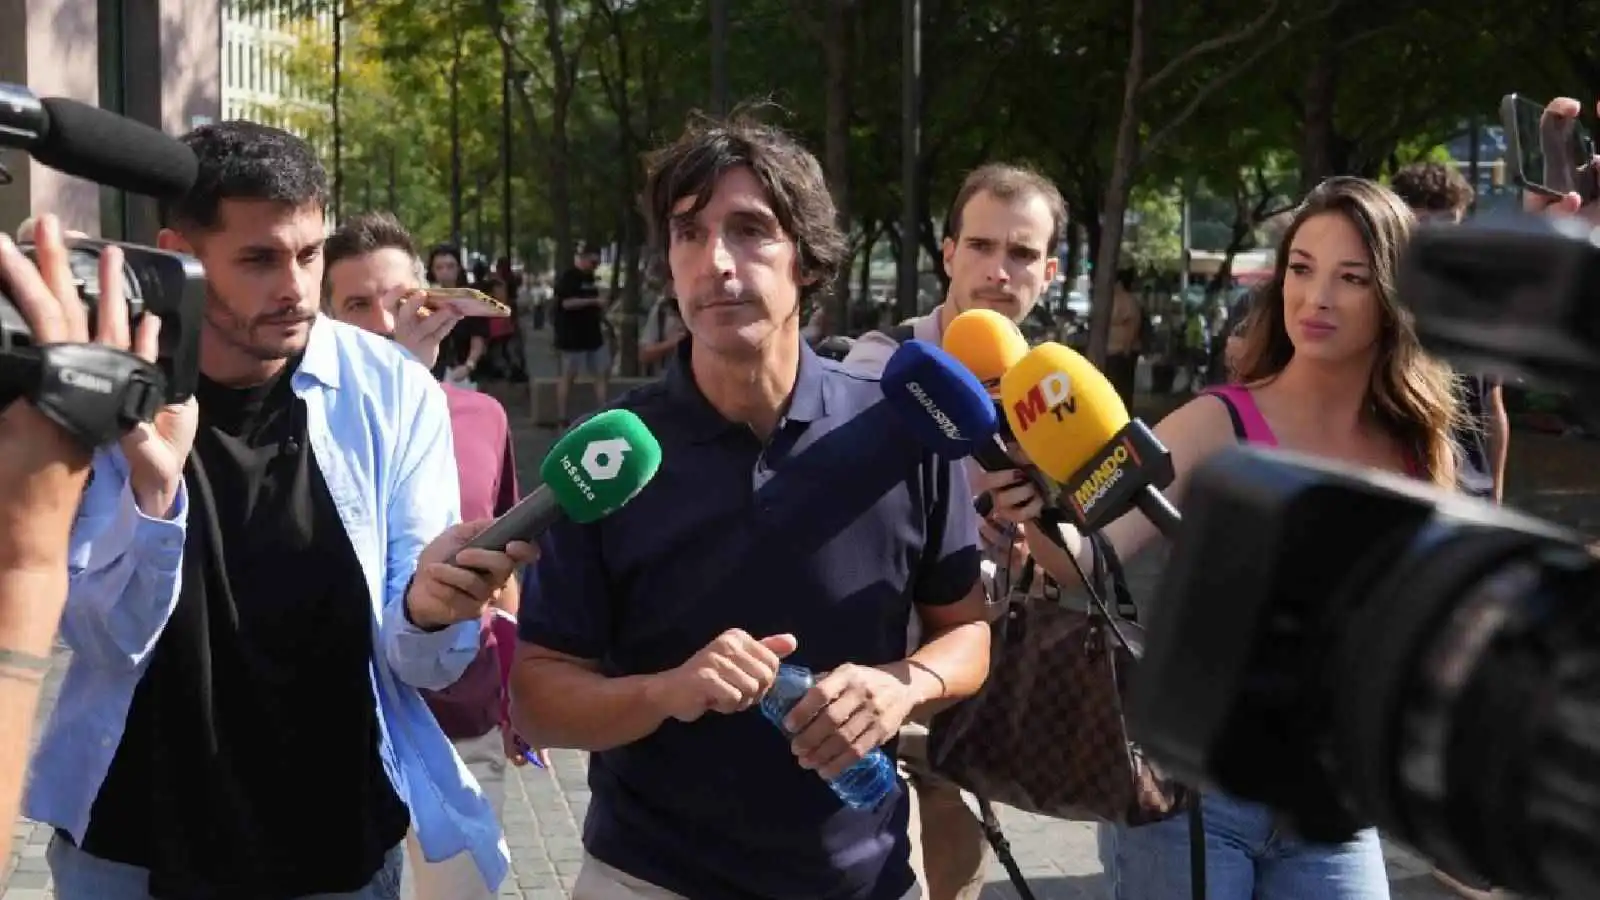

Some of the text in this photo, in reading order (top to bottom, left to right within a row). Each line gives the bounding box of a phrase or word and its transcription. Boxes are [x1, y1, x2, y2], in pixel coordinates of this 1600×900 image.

[1013, 371, 1070, 432] MD
[1050, 396, 1076, 422] TV
[560, 454, 596, 501] laSexta
[1074, 446, 1128, 506] MUNDO
